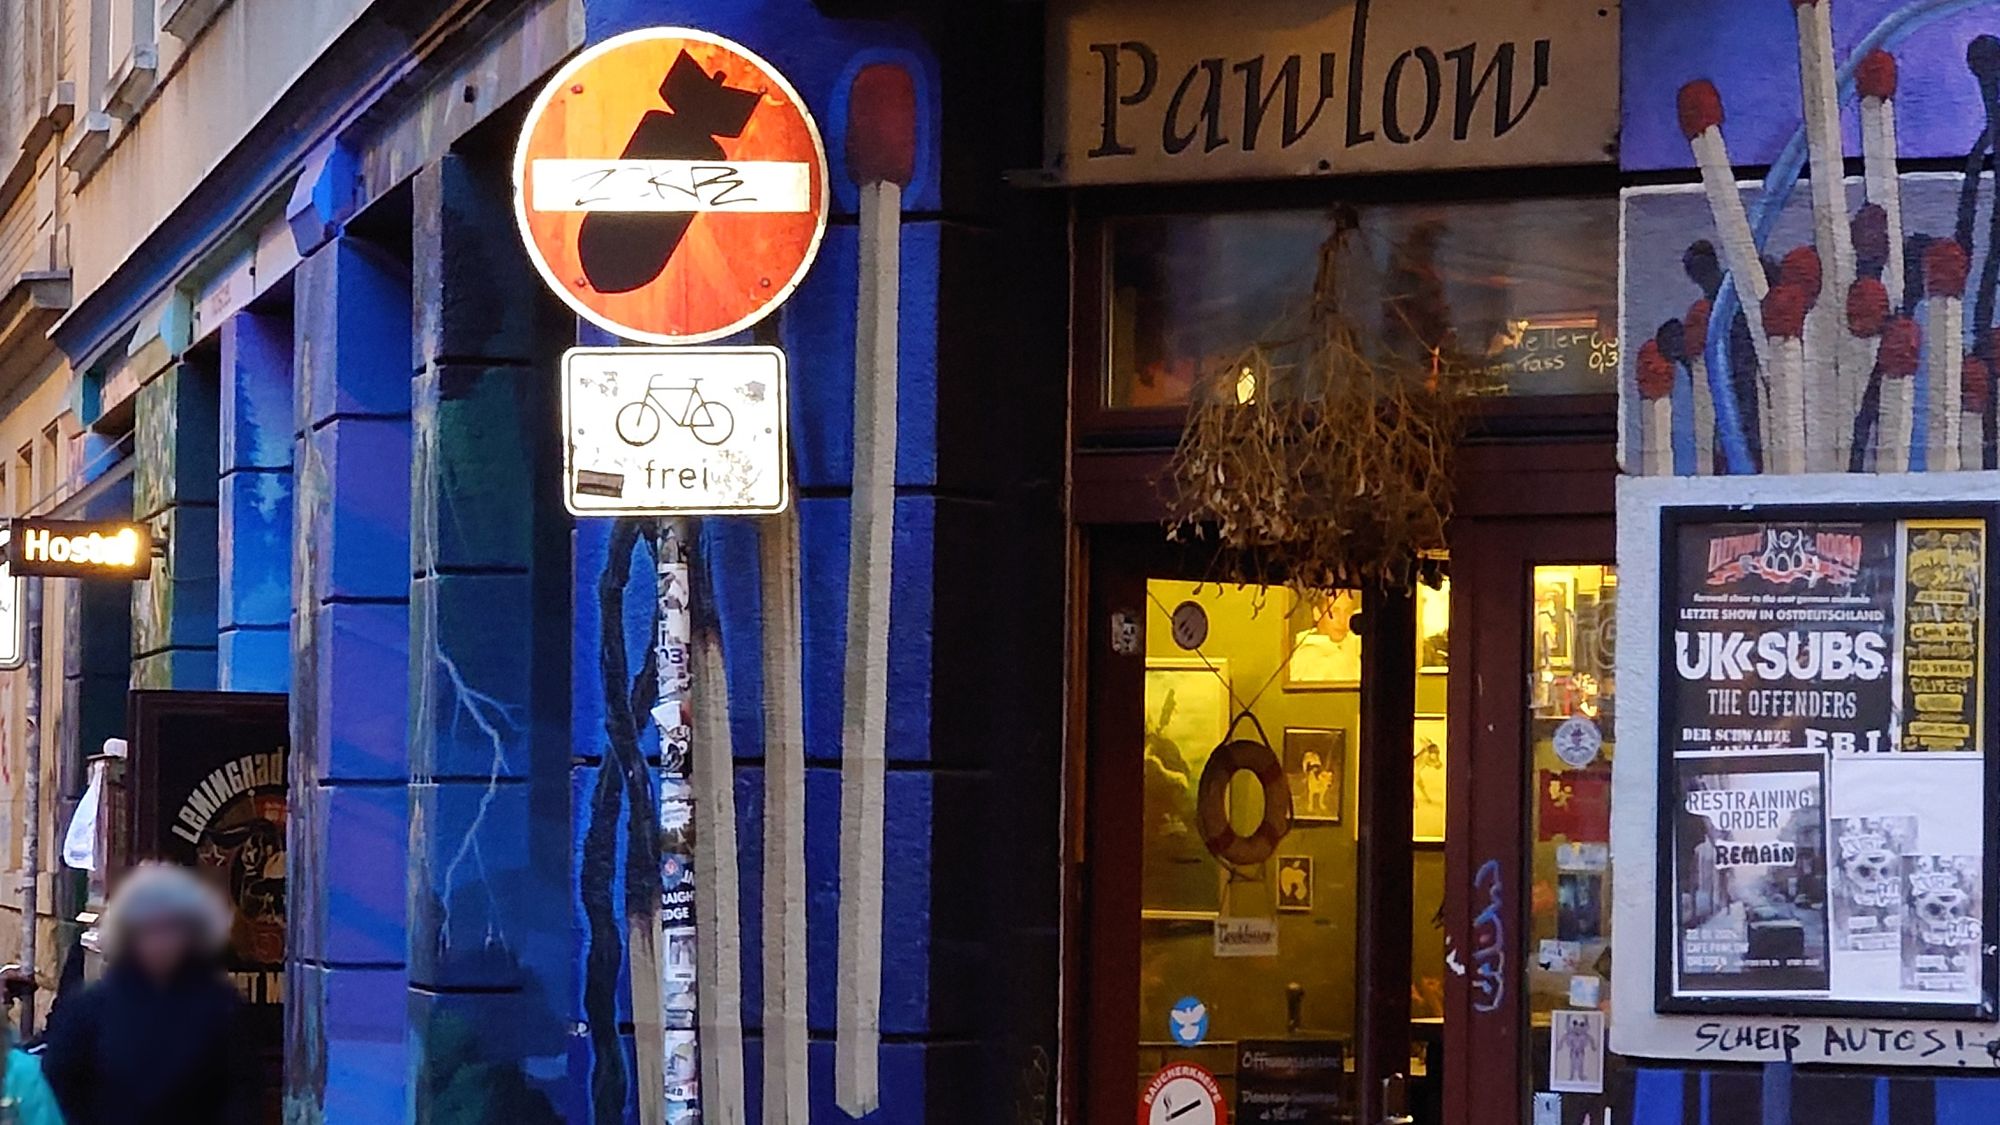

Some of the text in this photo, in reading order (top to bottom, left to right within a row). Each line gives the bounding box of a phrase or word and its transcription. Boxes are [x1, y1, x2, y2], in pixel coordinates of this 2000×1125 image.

[1088, 0, 1552, 158] Pawlow
[1588, 350, 1618, 374] 0,3
[645, 459, 709, 491] frei
[1681, 609, 1884, 621] LETZTE SHOW IN OSTDEUTSCHLAND
[1708, 689, 1857, 718] THE OFFENDERS
[1682, 728, 1791, 743] DER SCHWARZE
[1688, 790, 1810, 811] RESTRAINING
[1719, 810, 1778, 830] ORDER
